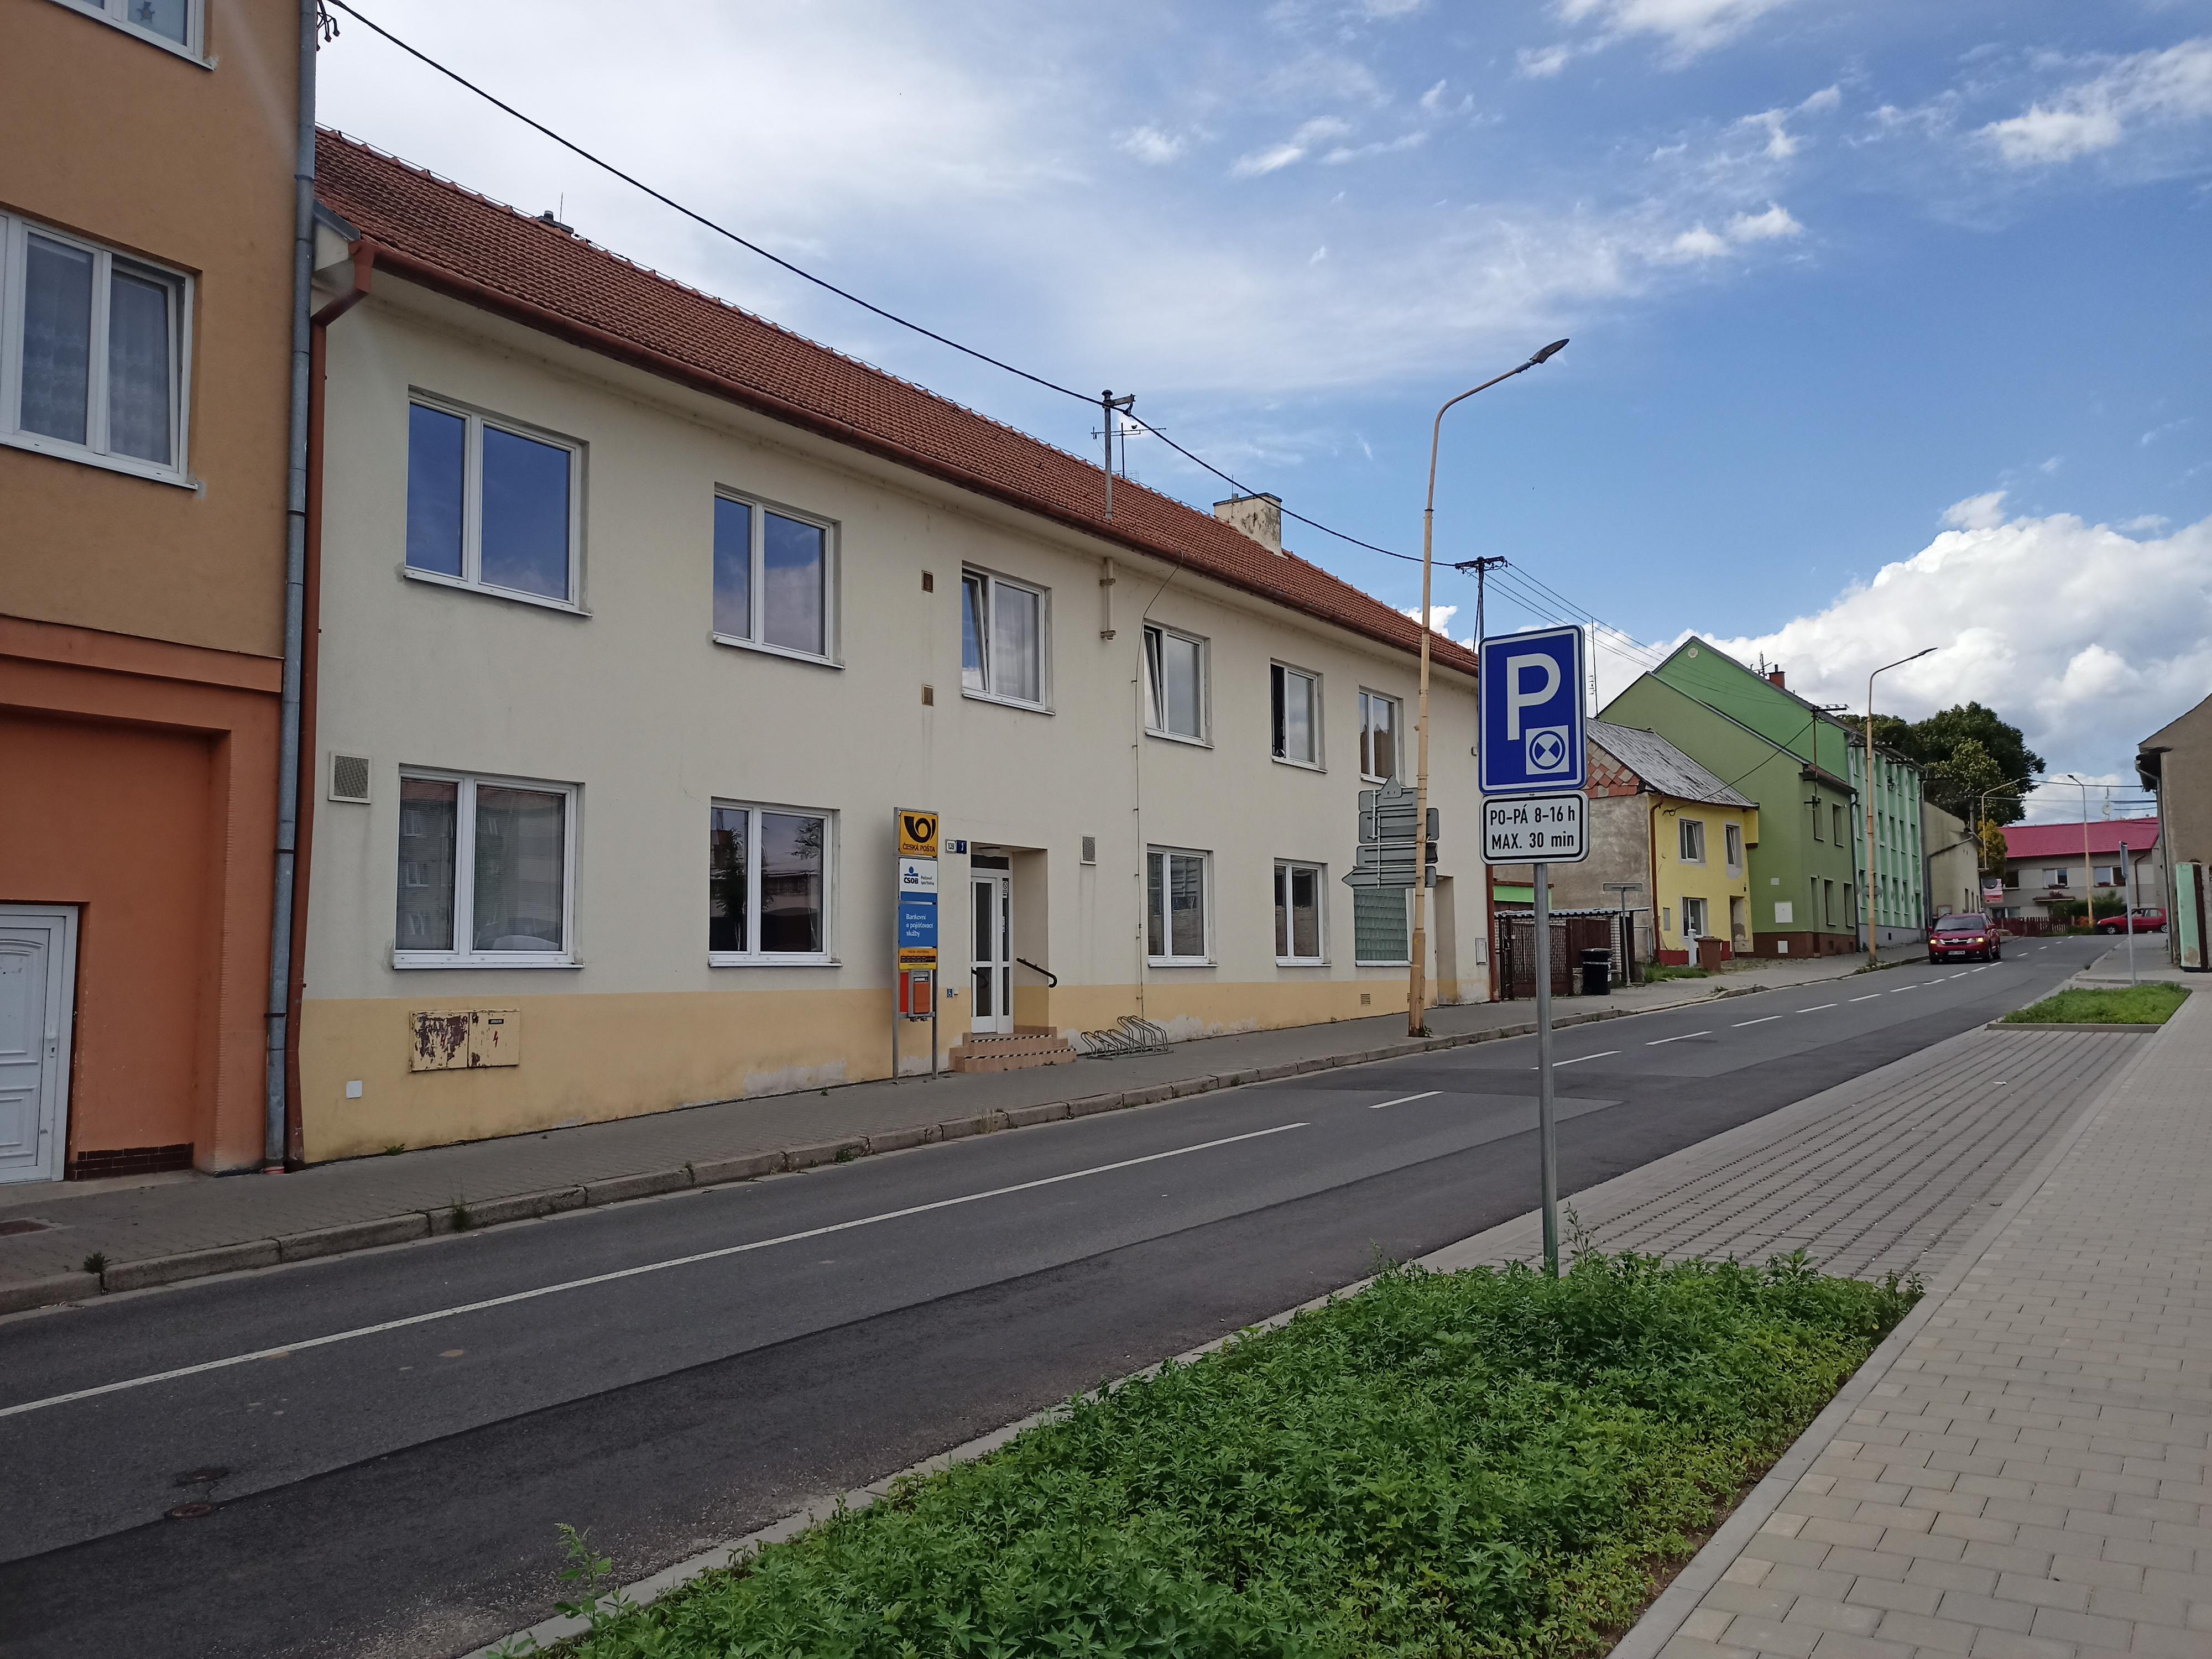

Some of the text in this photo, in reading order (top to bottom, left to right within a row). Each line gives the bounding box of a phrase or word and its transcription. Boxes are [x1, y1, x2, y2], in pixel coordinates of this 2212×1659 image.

[1507, 653, 1561, 740] P
[1490, 804, 1575, 825] PO-PÁ 8-16 h
[902, 842, 919, 851] ČESKÁ
[1491, 831, 1574, 850] MAX. 30 min
